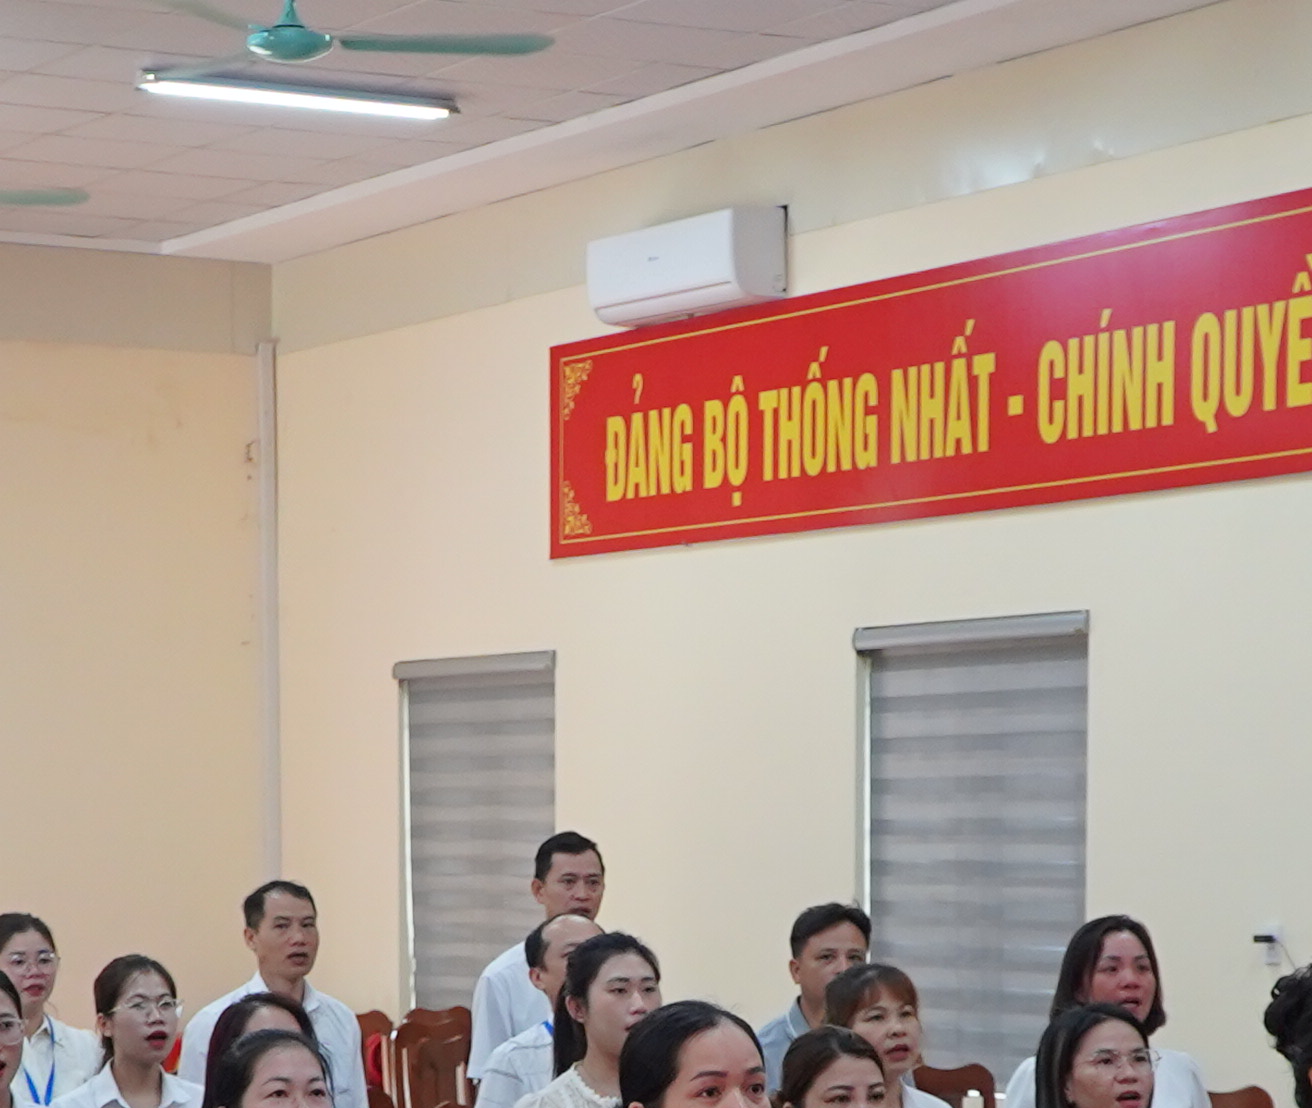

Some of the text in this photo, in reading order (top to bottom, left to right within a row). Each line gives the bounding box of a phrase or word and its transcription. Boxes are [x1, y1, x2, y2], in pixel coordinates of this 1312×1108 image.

[603, 372, 694, 502] ĐẢNG
[702, 374, 749, 507] BỘ
[757, 345, 880, 482] THỐNG
[889, 317, 996, 465] NHẤT
[1007, 393, 1025, 418] -
[1036, 307, 1177, 445] CHÍNH
